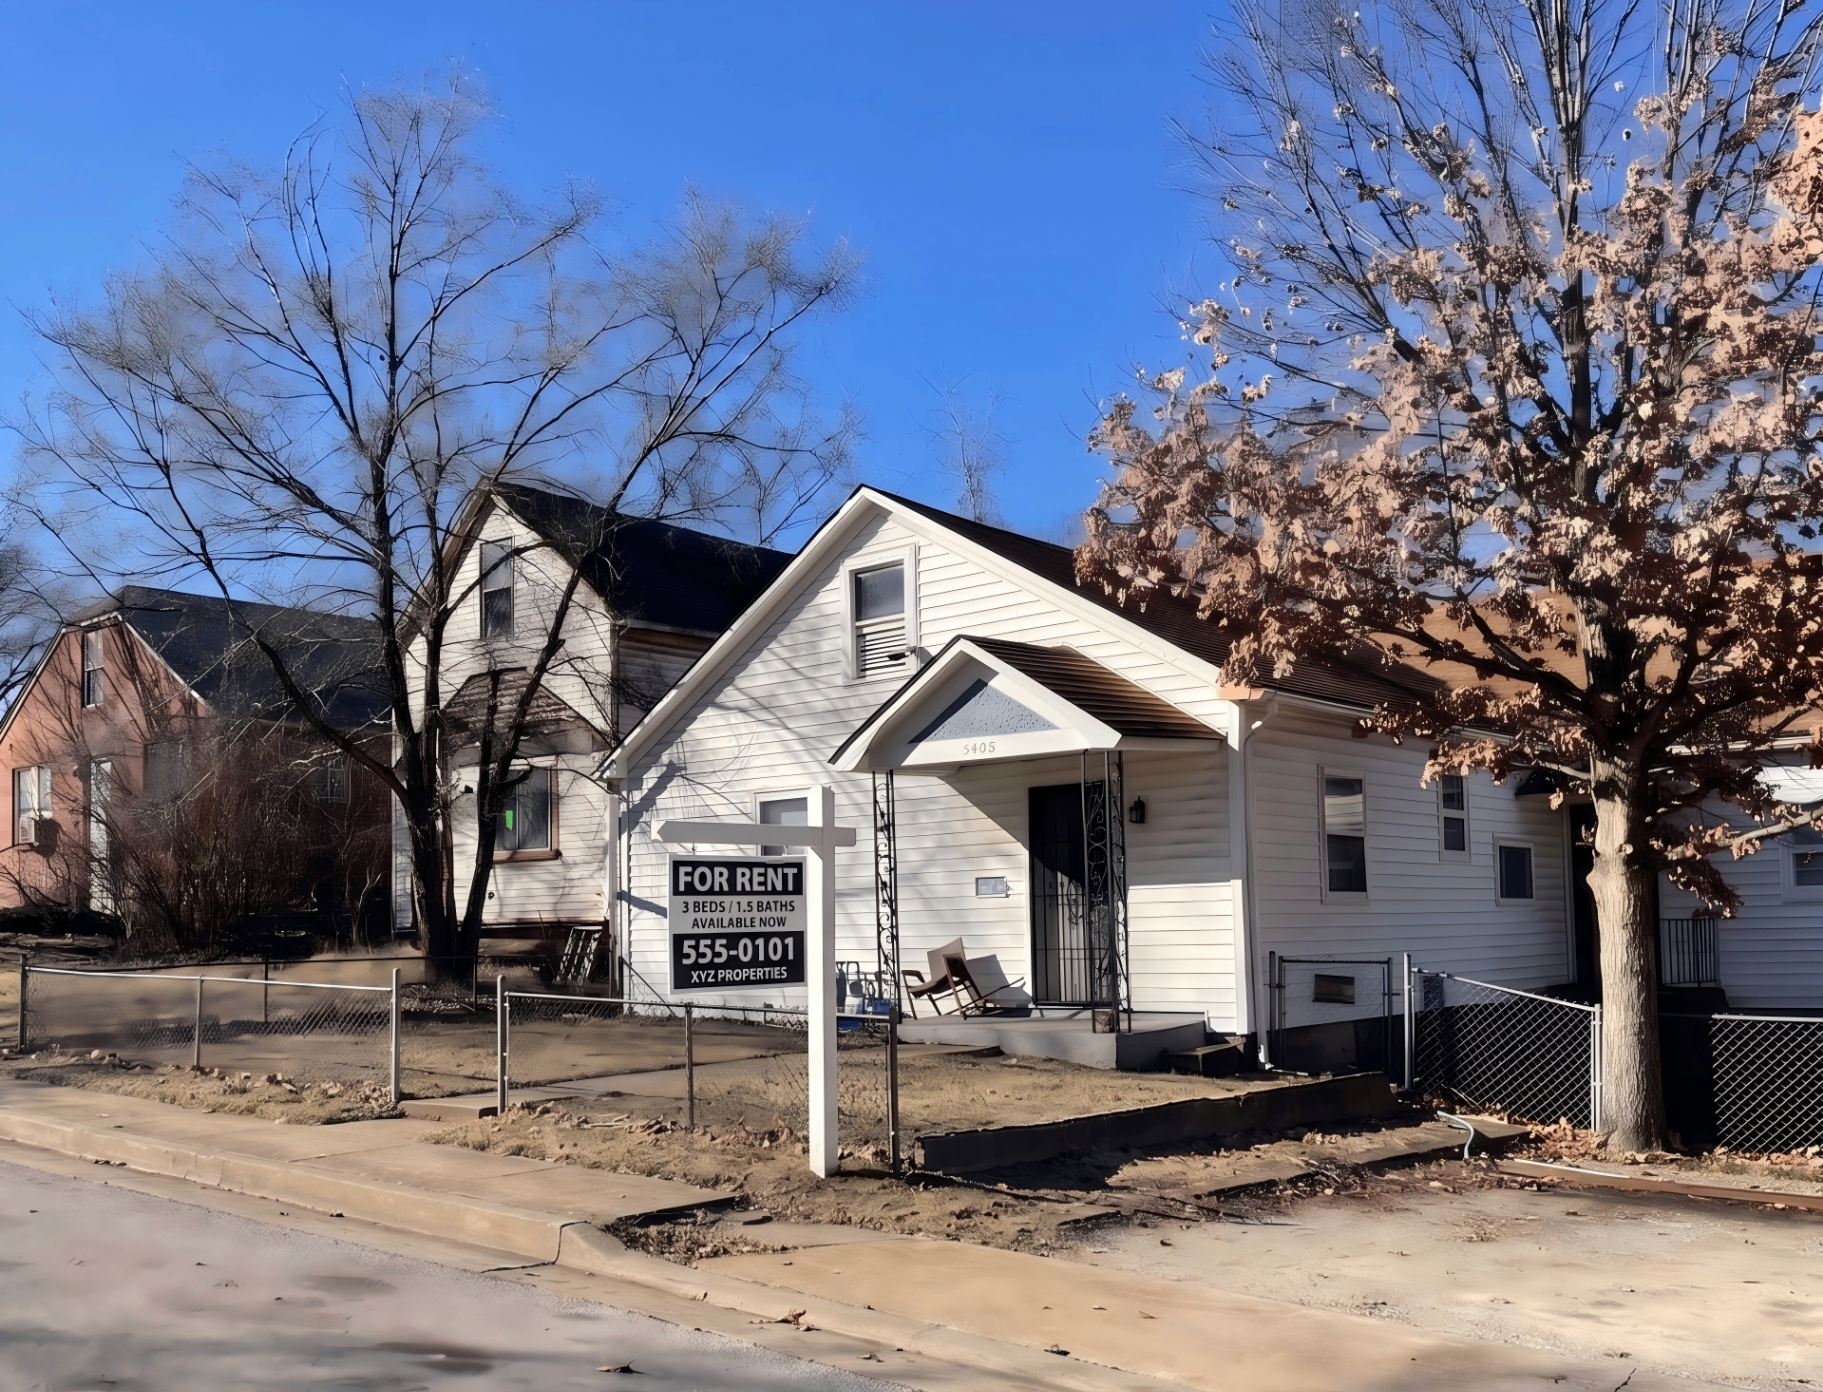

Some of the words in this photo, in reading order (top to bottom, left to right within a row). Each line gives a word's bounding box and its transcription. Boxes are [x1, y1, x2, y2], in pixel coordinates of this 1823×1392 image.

[963, 741, 996, 755] 5405
[678, 866, 729, 892] FOR
[736, 867, 798, 892] RENT
[682, 901, 690, 914] 3
[693, 901, 726, 913] BEDS
[728, 901, 733, 914] /
[736, 901, 753, 913] 1.5
[757, 900, 795, 912] BATHS
[691, 917, 756, 929] AVAILABLE
[759, 916, 787, 927] NOW
[681, 936, 794, 965] 555-0101
[691, 970, 715, 984] XYZ
[717, 966, 787, 982] PROPERTIES
